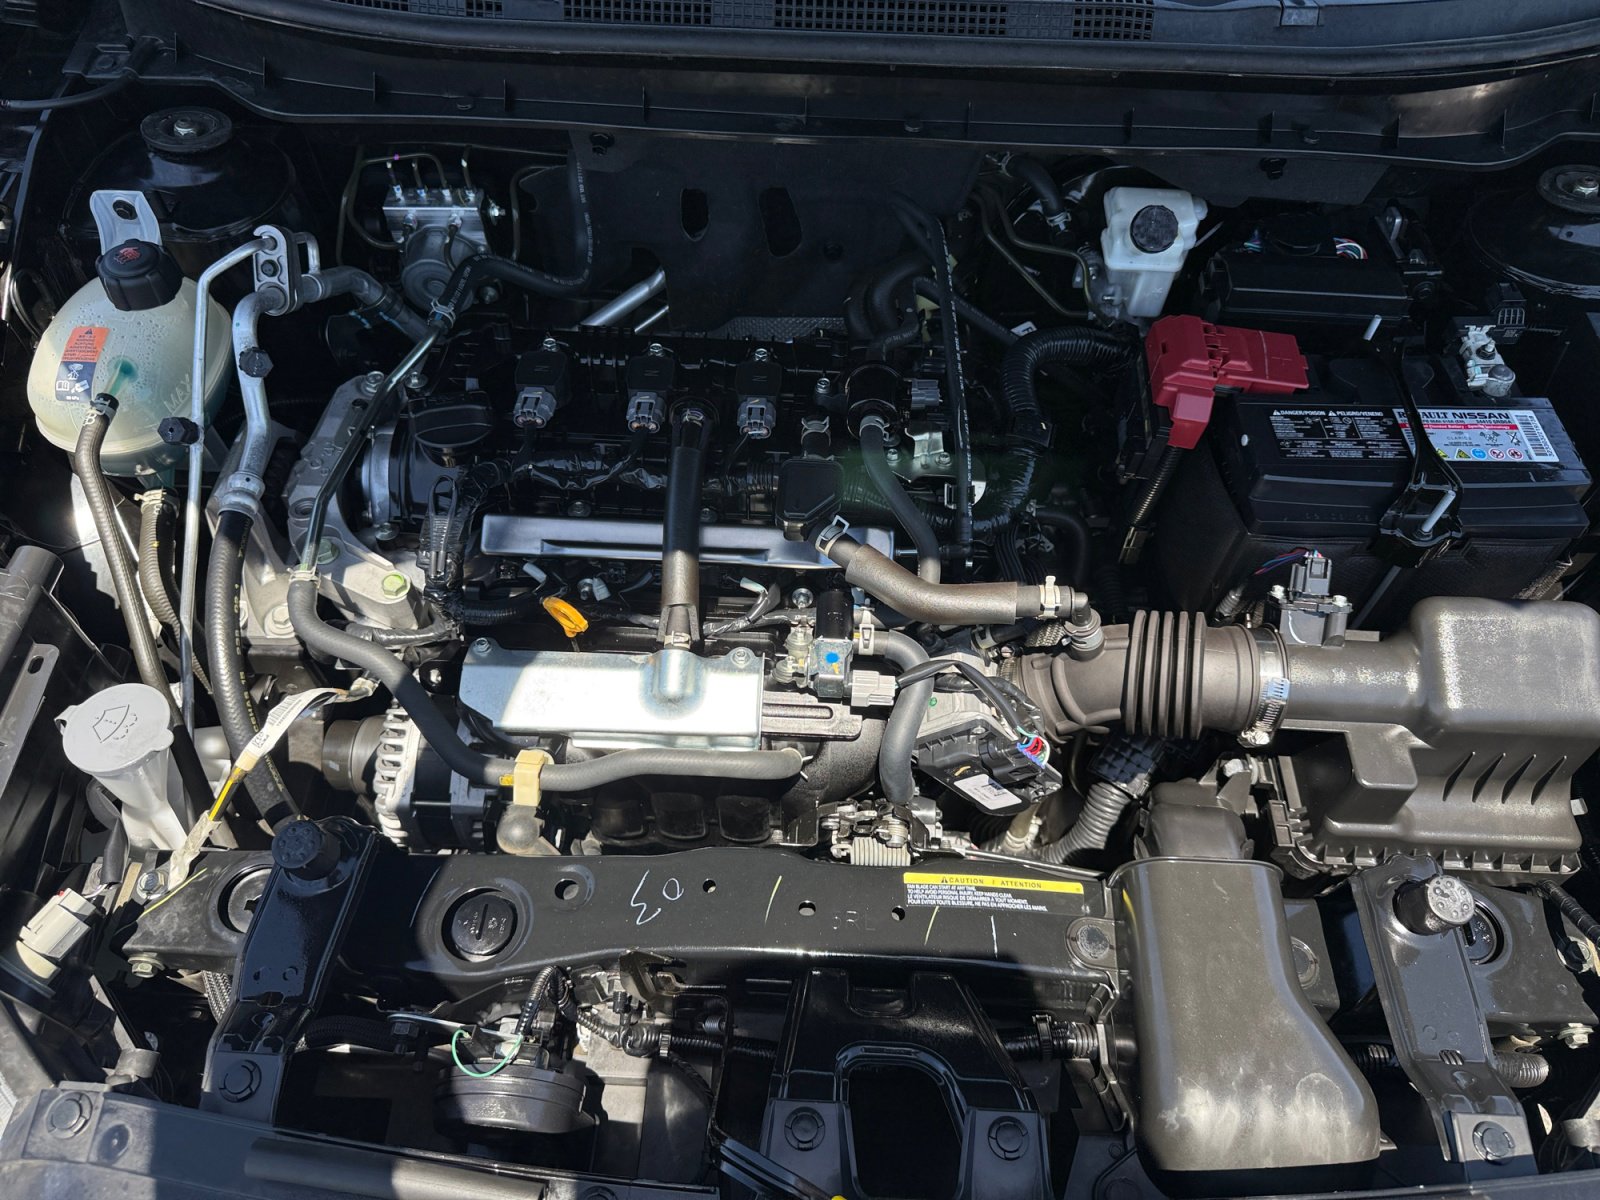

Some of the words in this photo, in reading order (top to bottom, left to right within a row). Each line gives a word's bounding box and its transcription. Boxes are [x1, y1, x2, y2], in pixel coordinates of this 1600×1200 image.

[1397, 411, 1448, 419] RAULT
[1451, 412, 1511, 420] NISSAN
[949, 877, 984, 885] CAUTION
[1000, 880, 1042, 889] ATTENTION
